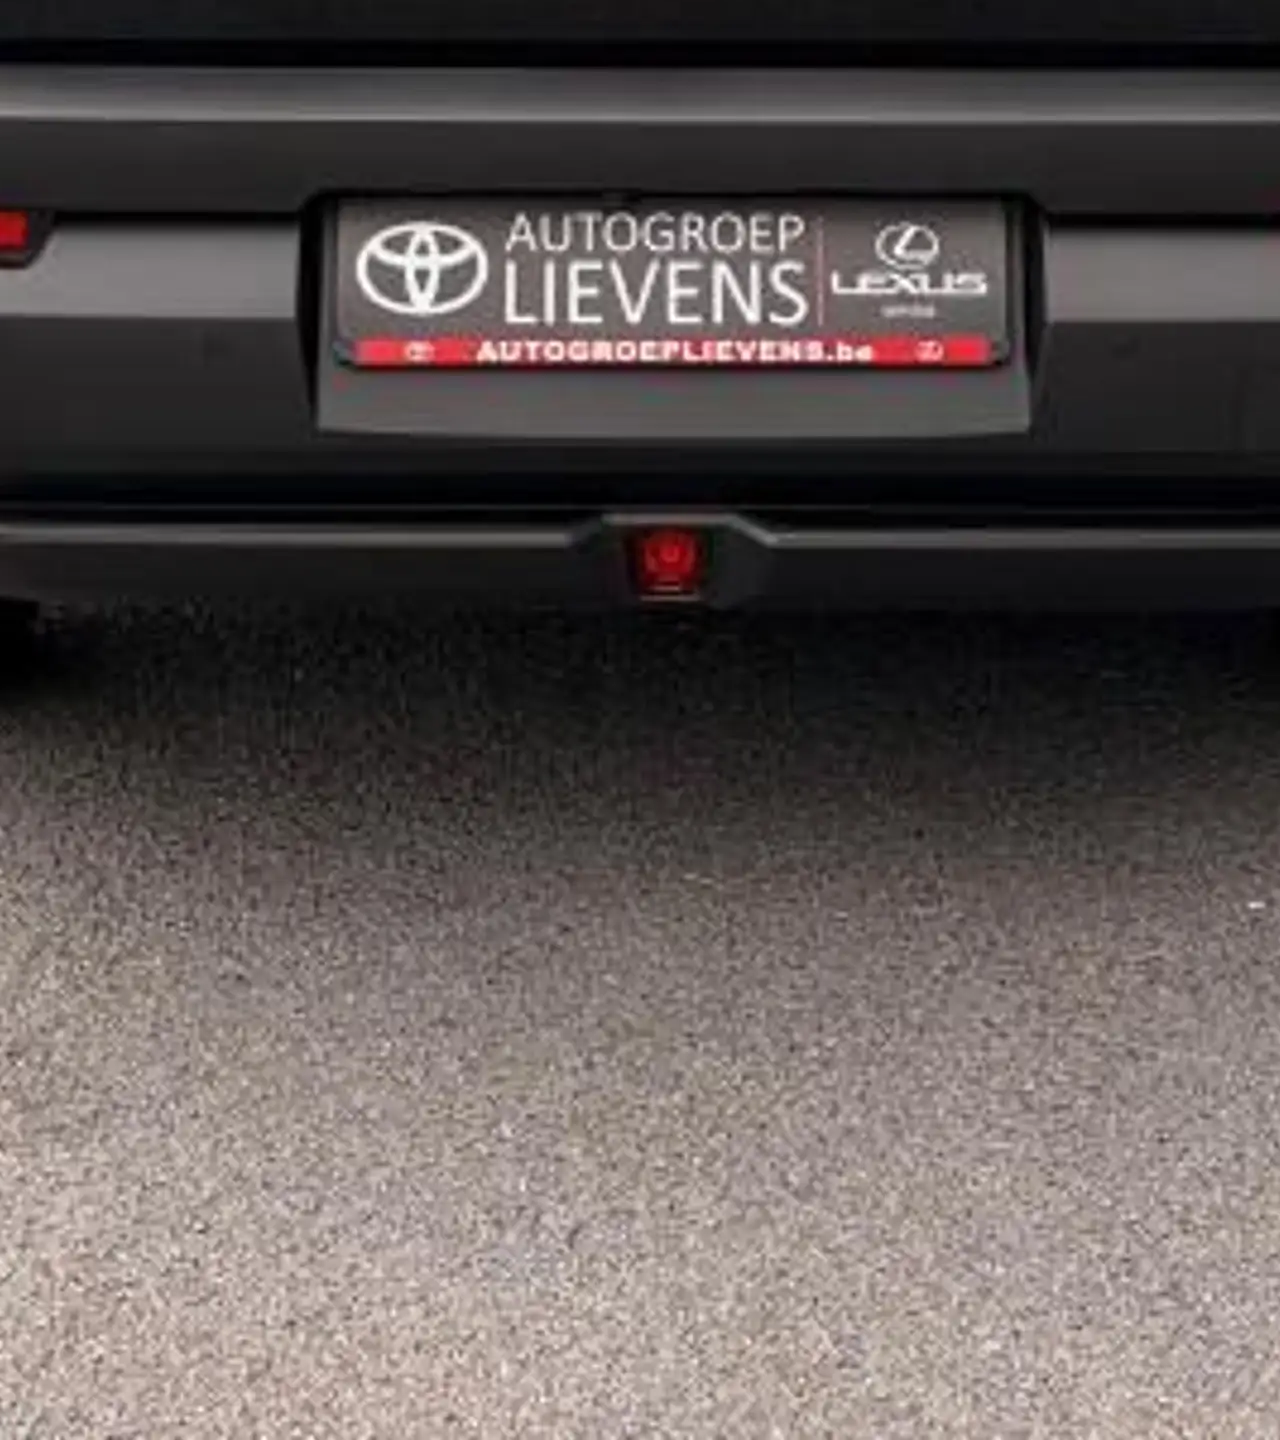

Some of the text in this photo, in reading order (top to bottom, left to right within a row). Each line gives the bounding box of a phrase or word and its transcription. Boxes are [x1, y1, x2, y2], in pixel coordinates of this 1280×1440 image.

[505, 212, 805, 253] AUTOGROEP
[505, 259, 810, 326] LIEVENS
[830, 269, 988, 295] LEXUS
[476, 340, 874, 363] AUTOGROEPLIEVENS.be
